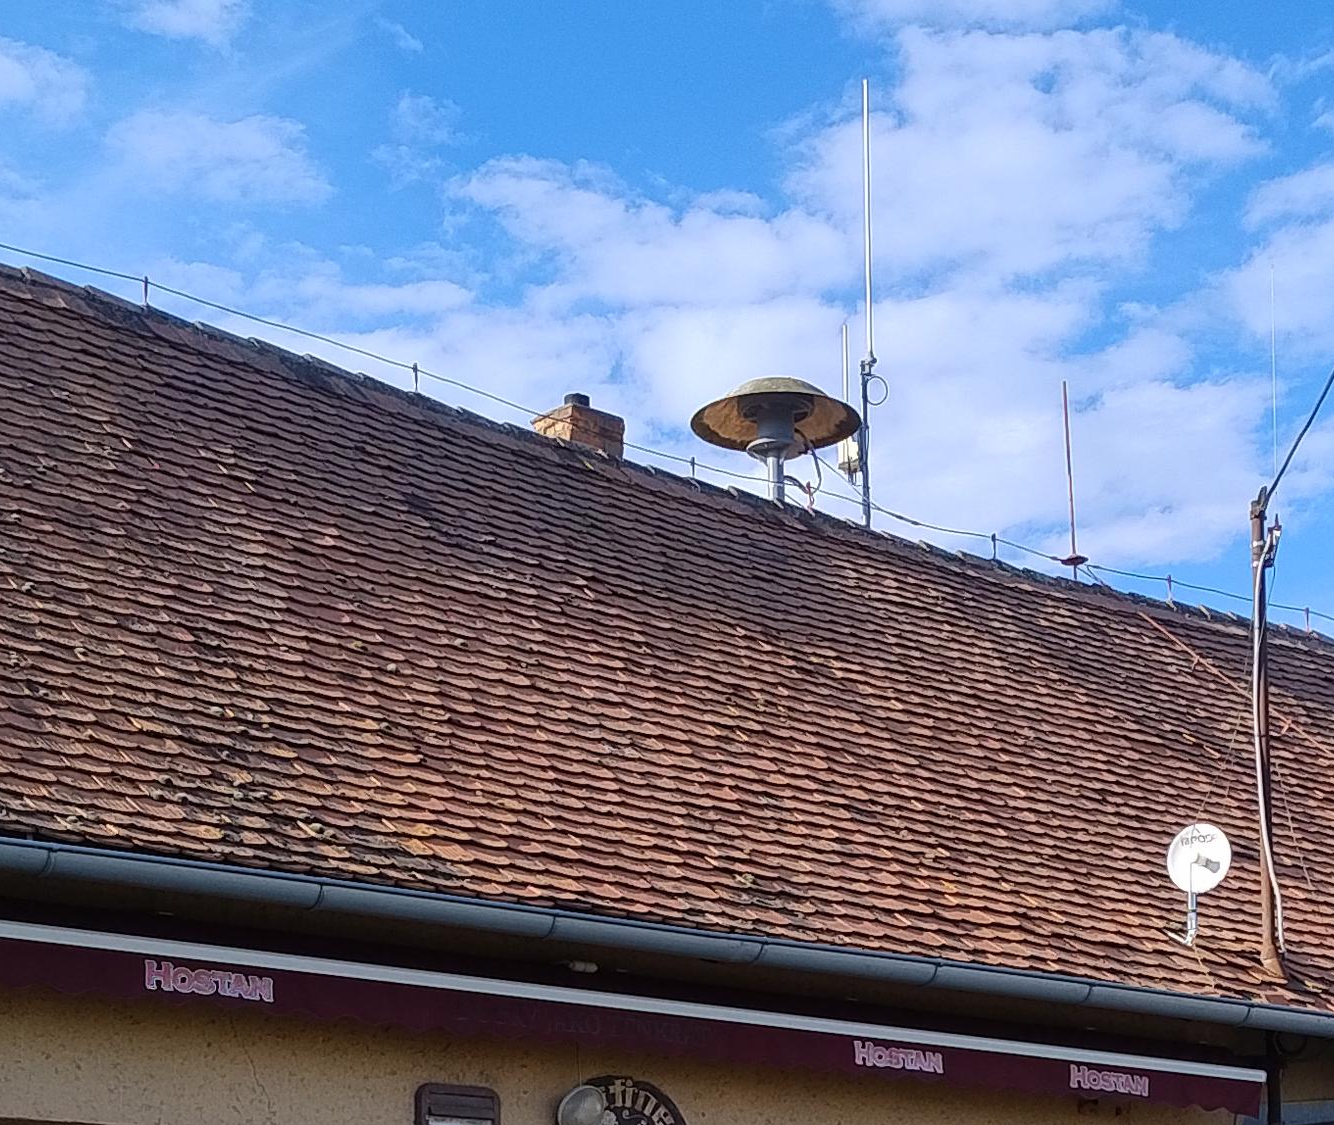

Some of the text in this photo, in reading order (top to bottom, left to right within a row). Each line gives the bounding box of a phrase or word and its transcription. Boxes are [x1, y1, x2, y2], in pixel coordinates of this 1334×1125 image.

[144, 959, 275, 1003] HOSTAN
[853, 1041, 945, 1074] HOSTAN
[1069, 1064, 1150, 1097] HOSTAN
